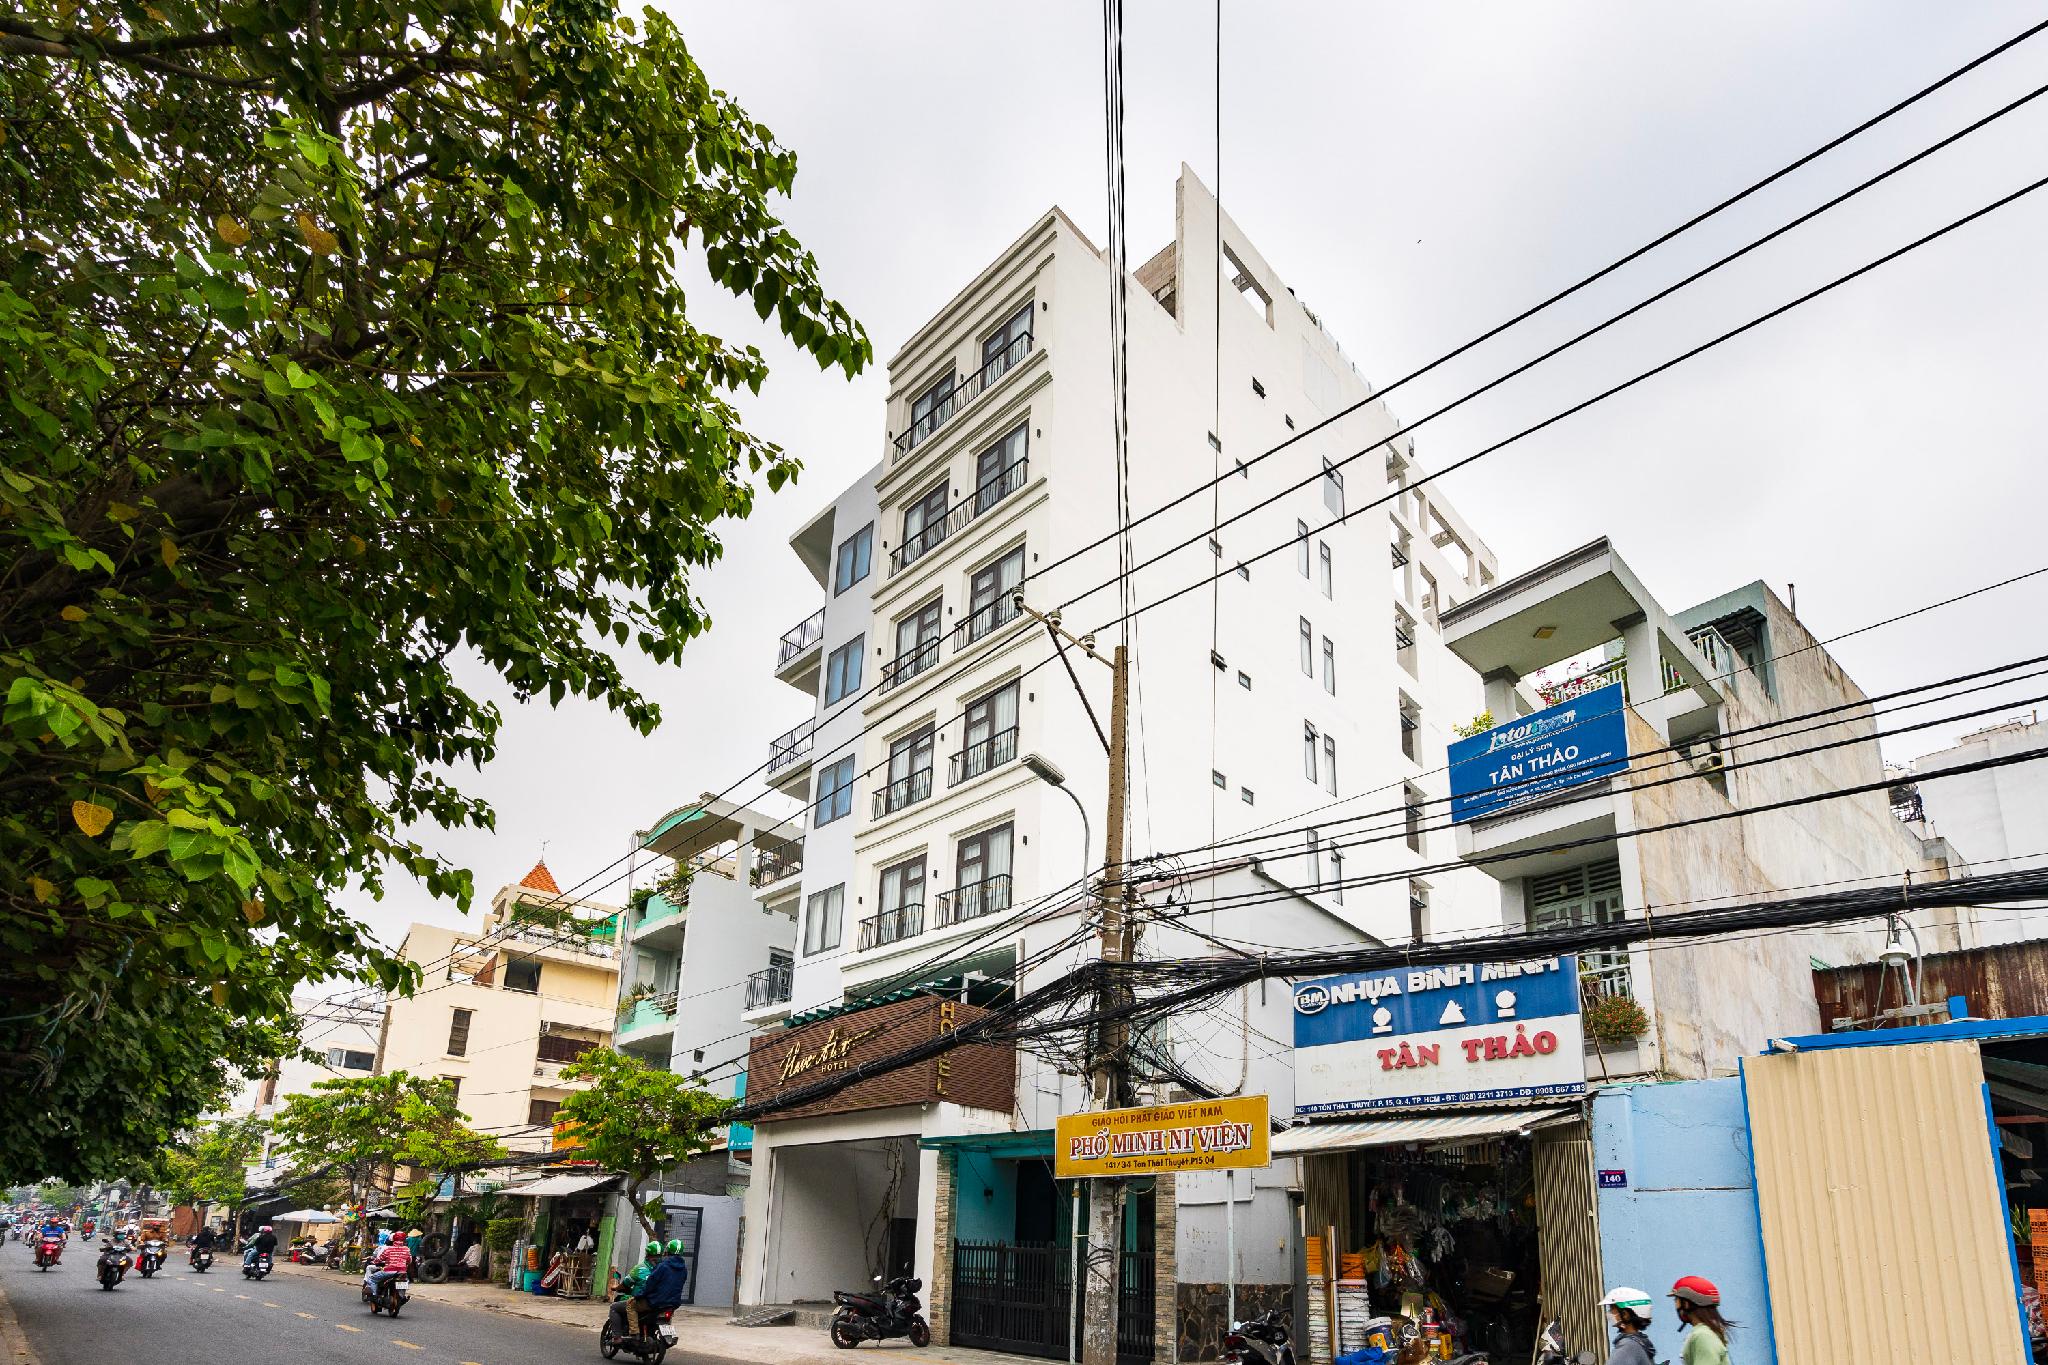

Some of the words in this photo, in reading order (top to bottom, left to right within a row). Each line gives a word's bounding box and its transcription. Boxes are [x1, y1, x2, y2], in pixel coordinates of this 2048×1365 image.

[1489, 763, 1523, 785] TÂN
[1527, 745, 1579, 772] THẢO
[1330, 976, 1402, 1006] NHỰA
[937, 1002, 955, 1097] HOEL
[1377, 1041, 1440, 1071] TÂN
[1461, 1023, 1558, 1063] THẢO
[1092, 1115, 1112, 1127] GIÁO
[1200, 1106, 1224, 1118] NAM
[1070, 1127, 1110, 1158] PHỔ
[1111, 1130, 1166, 1156] MINH
[1168, 1127, 1195, 1154] NI
[1195, 1119, 1252, 1153] VIỆN
[1605, 1175, 1621, 1183] 140
